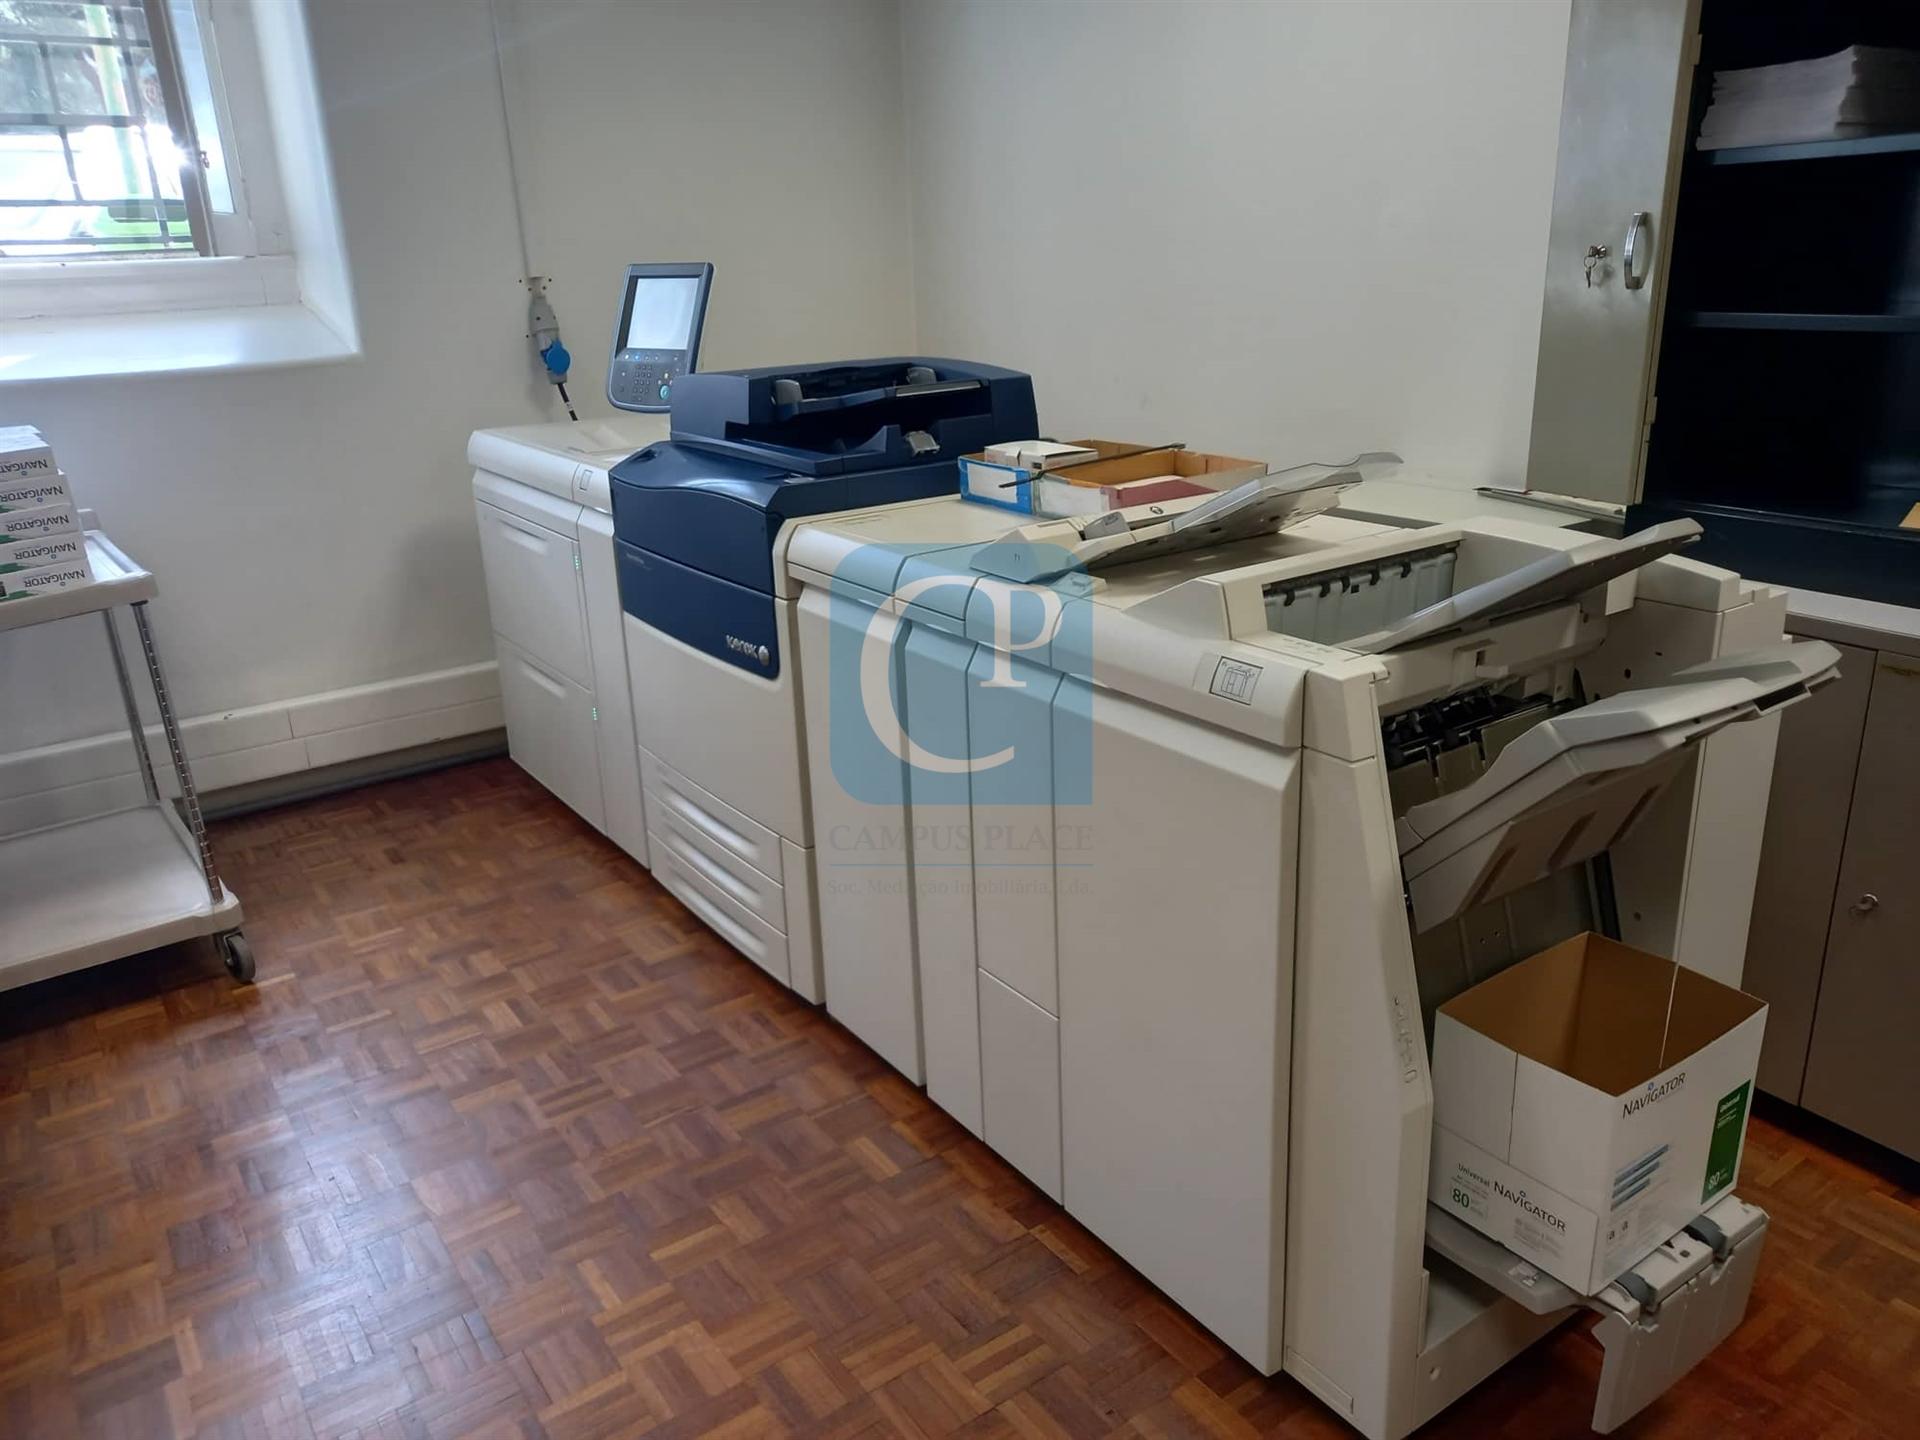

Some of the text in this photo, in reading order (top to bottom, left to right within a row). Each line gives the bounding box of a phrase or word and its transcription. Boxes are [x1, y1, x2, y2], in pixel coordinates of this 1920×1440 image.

[0, 485, 63, 502] NAVIGATOR
[6, 514, 69, 532] NAVIGATOR
[13, 542, 76, 560] NAVIGATOR
[24, 569, 85, 588] NAVIGATOR
[1622, 1072, 1686, 1120] NAVIGATOR
[1452, 1188, 1470, 1208] 80
[1458, 1163, 1490, 1187] Universal
[1494, 1181, 1566, 1232] NAVIGATOR
